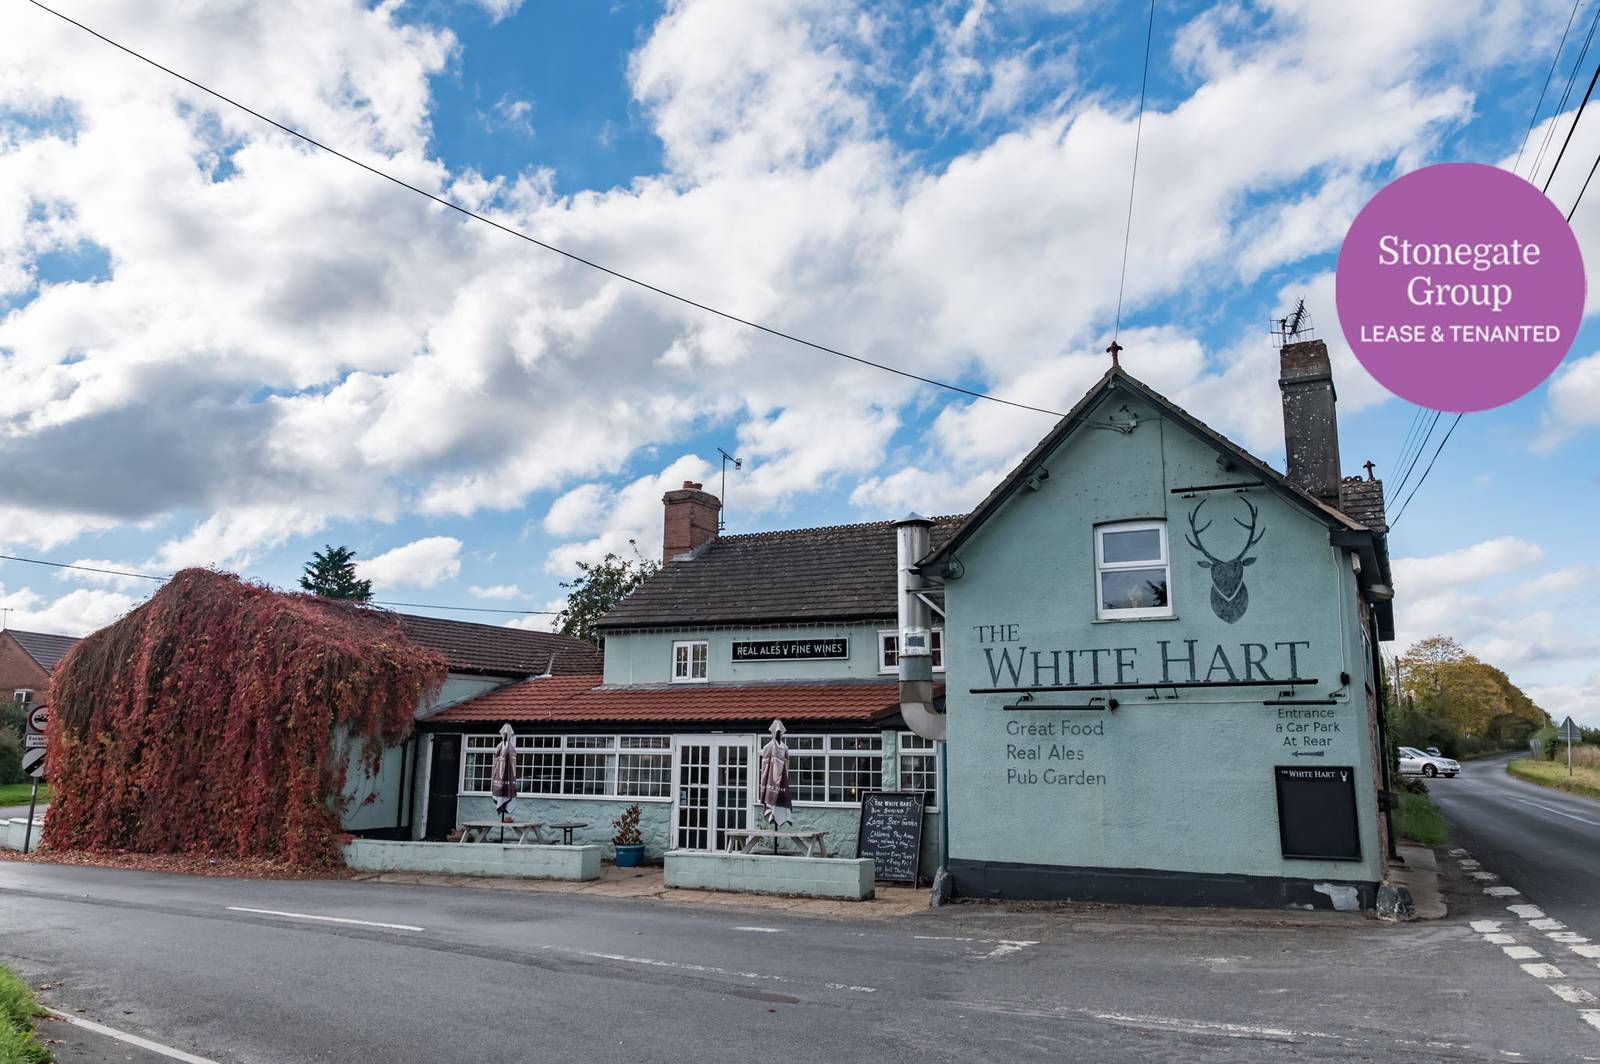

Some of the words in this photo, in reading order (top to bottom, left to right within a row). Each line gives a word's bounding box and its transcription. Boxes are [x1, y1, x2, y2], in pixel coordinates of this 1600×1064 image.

[973, 624, 1020, 644] THE
[737, 646, 758, 656] REAL
[760, 645, 781, 656] ALES
[791, 644, 811, 654] FINE
[813, 643, 843, 654] WINES
[983, 646, 1139, 688] WHITE
[1156, 639, 1310, 683] HART
[1278, 708, 1335, 719] Entrance
[1006, 719, 1056, 737] Great
[1060, 719, 1105, 737] Food
[1275, 723, 1283, 733] &
[1286, 722, 1310, 733] Car
[1313, 722, 1341, 733] Park
[1283, 736, 1298, 747] At
[1303, 736, 1333, 747] Rear
[1006, 744, 1041, 760] Real
[1047, 743, 1086, 762] Ales
[1006, 768, 1039, 785] Pub
[1043, 768, 1107, 786] Garden
[1288, 769, 1313, 778] WHITE
[1314, 770, 1336, 778] HART
